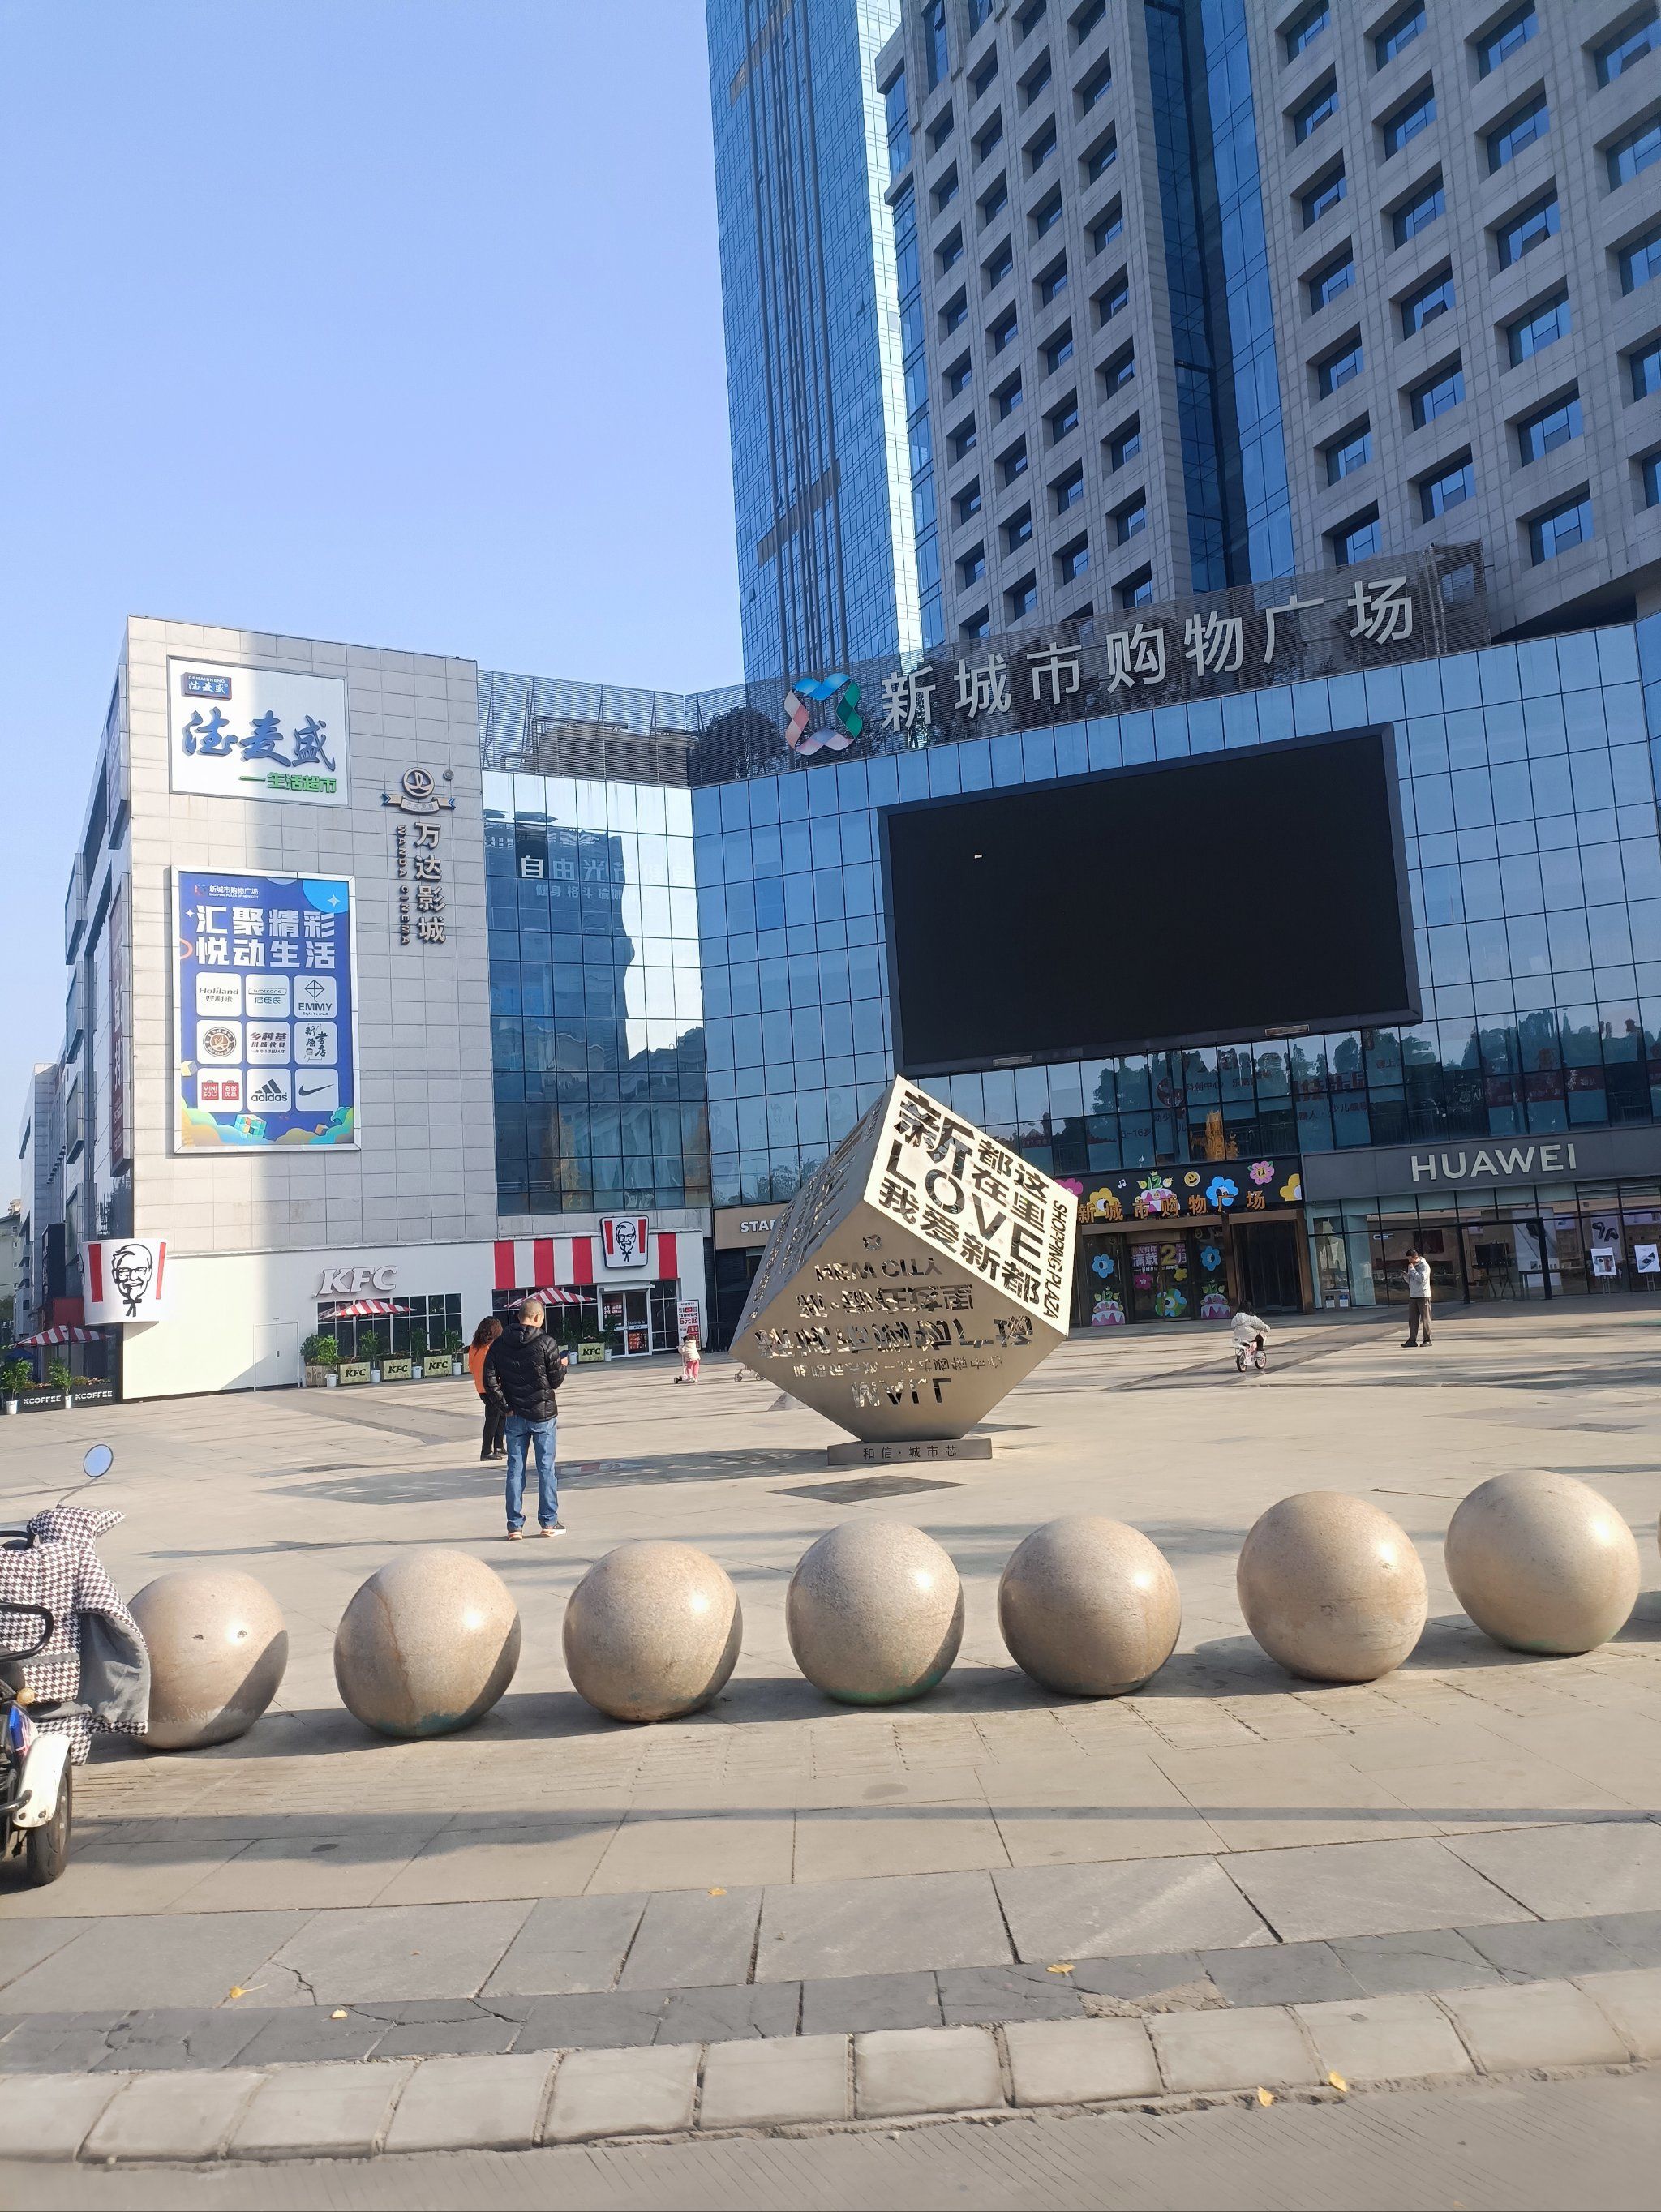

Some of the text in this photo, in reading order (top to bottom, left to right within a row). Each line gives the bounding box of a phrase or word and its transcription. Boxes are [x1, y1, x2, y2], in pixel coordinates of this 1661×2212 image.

[881, 576, 1414, 731] 新城市购物广场
[182, 706, 336, 772] 德麦盛
[209, 885, 259, 895] 新城市购物广场
[397, 825, 410, 945] WANDA CINEMA
[414, 822, 446, 944] 万达影城
[196, 905, 335, 938] 汇聚精彩
[196, 937, 336, 969] 悦动生活
[298, 1003, 333, 1011] EMMY
[250, 1032, 287, 1041] 乡村基
[251, 1093, 288, 1102] adidas
[1411, 1143, 1577, 1181] HUAWEI
[886, 1139, 1044, 1275] LOVE
[1078, 1190, 1265, 1223] 新城市购物广场
[879, 1177, 1040, 1305] 我爱新都
[319, 1265, 397, 1295] KFC
[345, 1369, 366, 1377] KFC
[388, 1365, 408, 1374] KFC
[428, 1361, 448, 1370] KFC
[24, 1395, 62, 1405] KCOFFEE
[75, 1391, 113, 1400] KCOFFEE
